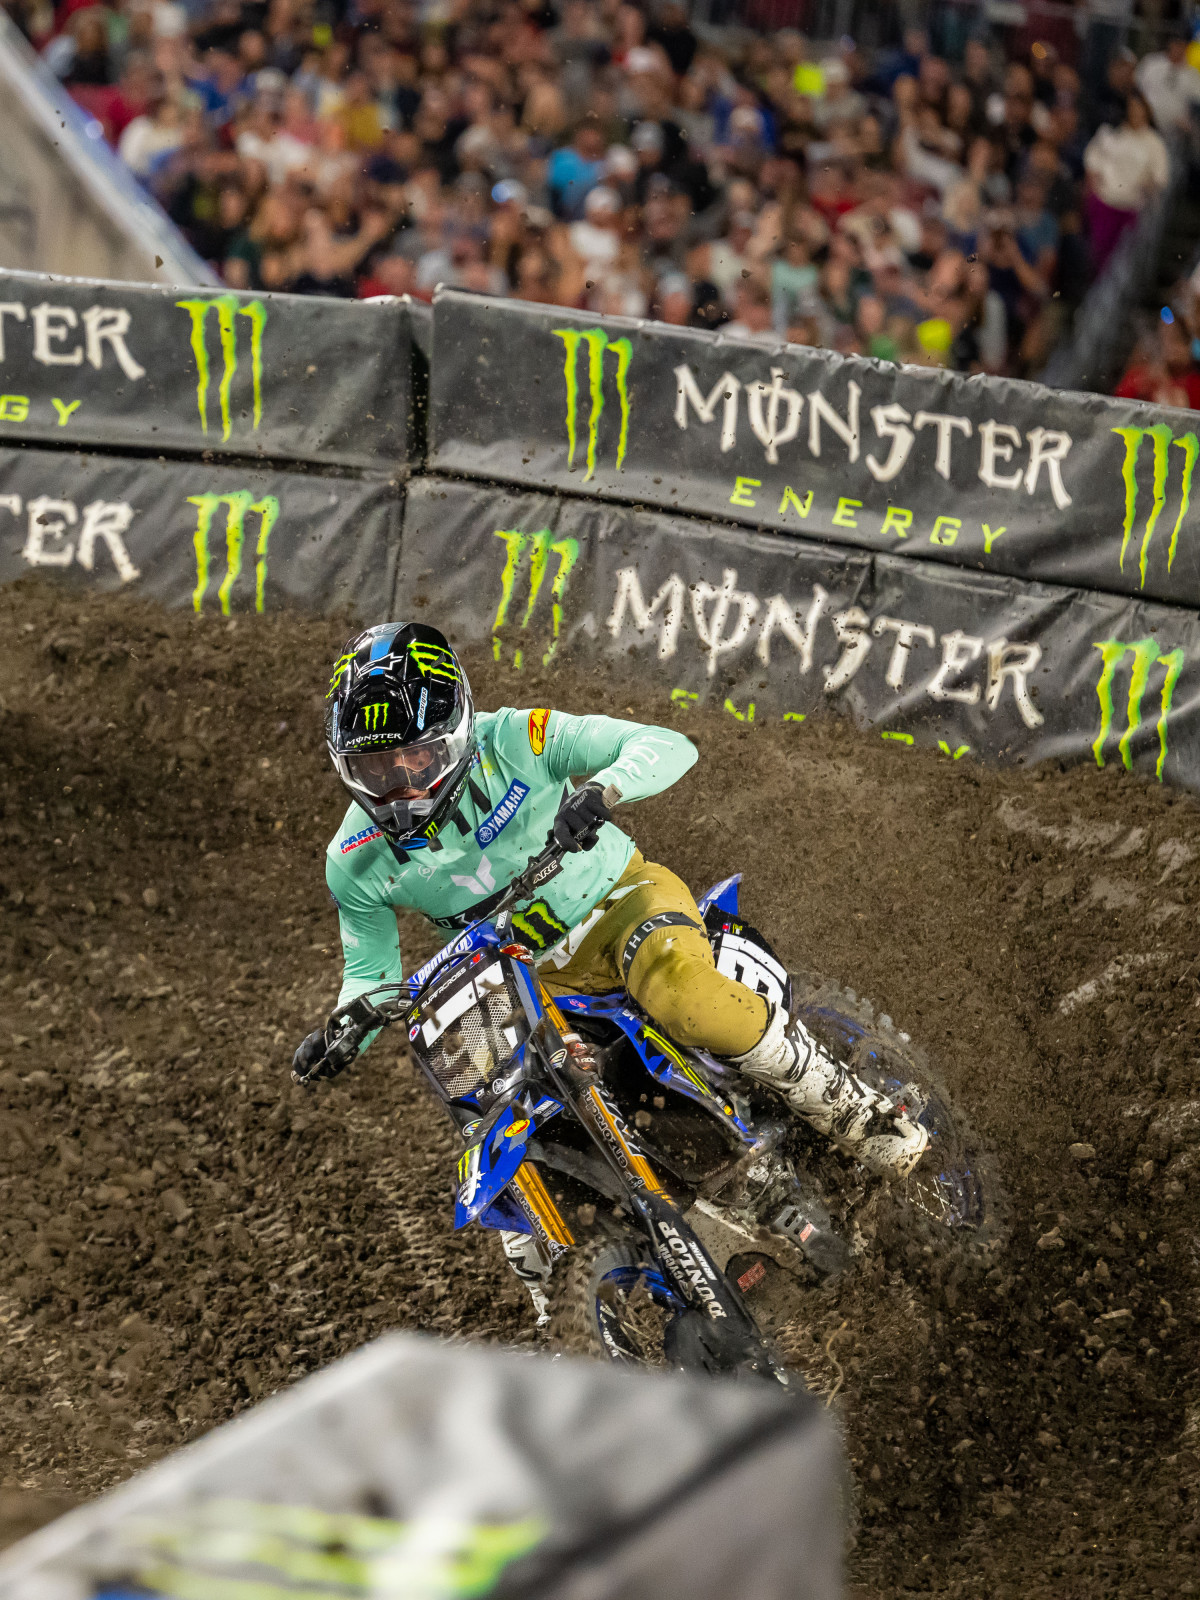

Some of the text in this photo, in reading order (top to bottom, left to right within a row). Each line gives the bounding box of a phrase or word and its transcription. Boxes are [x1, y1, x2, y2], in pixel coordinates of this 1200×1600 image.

[673, 364, 1073, 510] MONSTER
[729, 475, 1007, 555] ENERGY
[605, 565, 1046, 730] MONSTER
[345, 732, 403, 748] MONSTER
[487, 784, 527, 833] YAMAHA
[570, 790, 589, 811] THOR
[341, 831, 384, 855] UNLIMITE
[532, 859, 558, 885] ARC
[622, 914, 673, 964] THOR
[419, 967, 468, 1010] SUPERCROSS
[657, 1221, 727, 1319] DUNLOP
